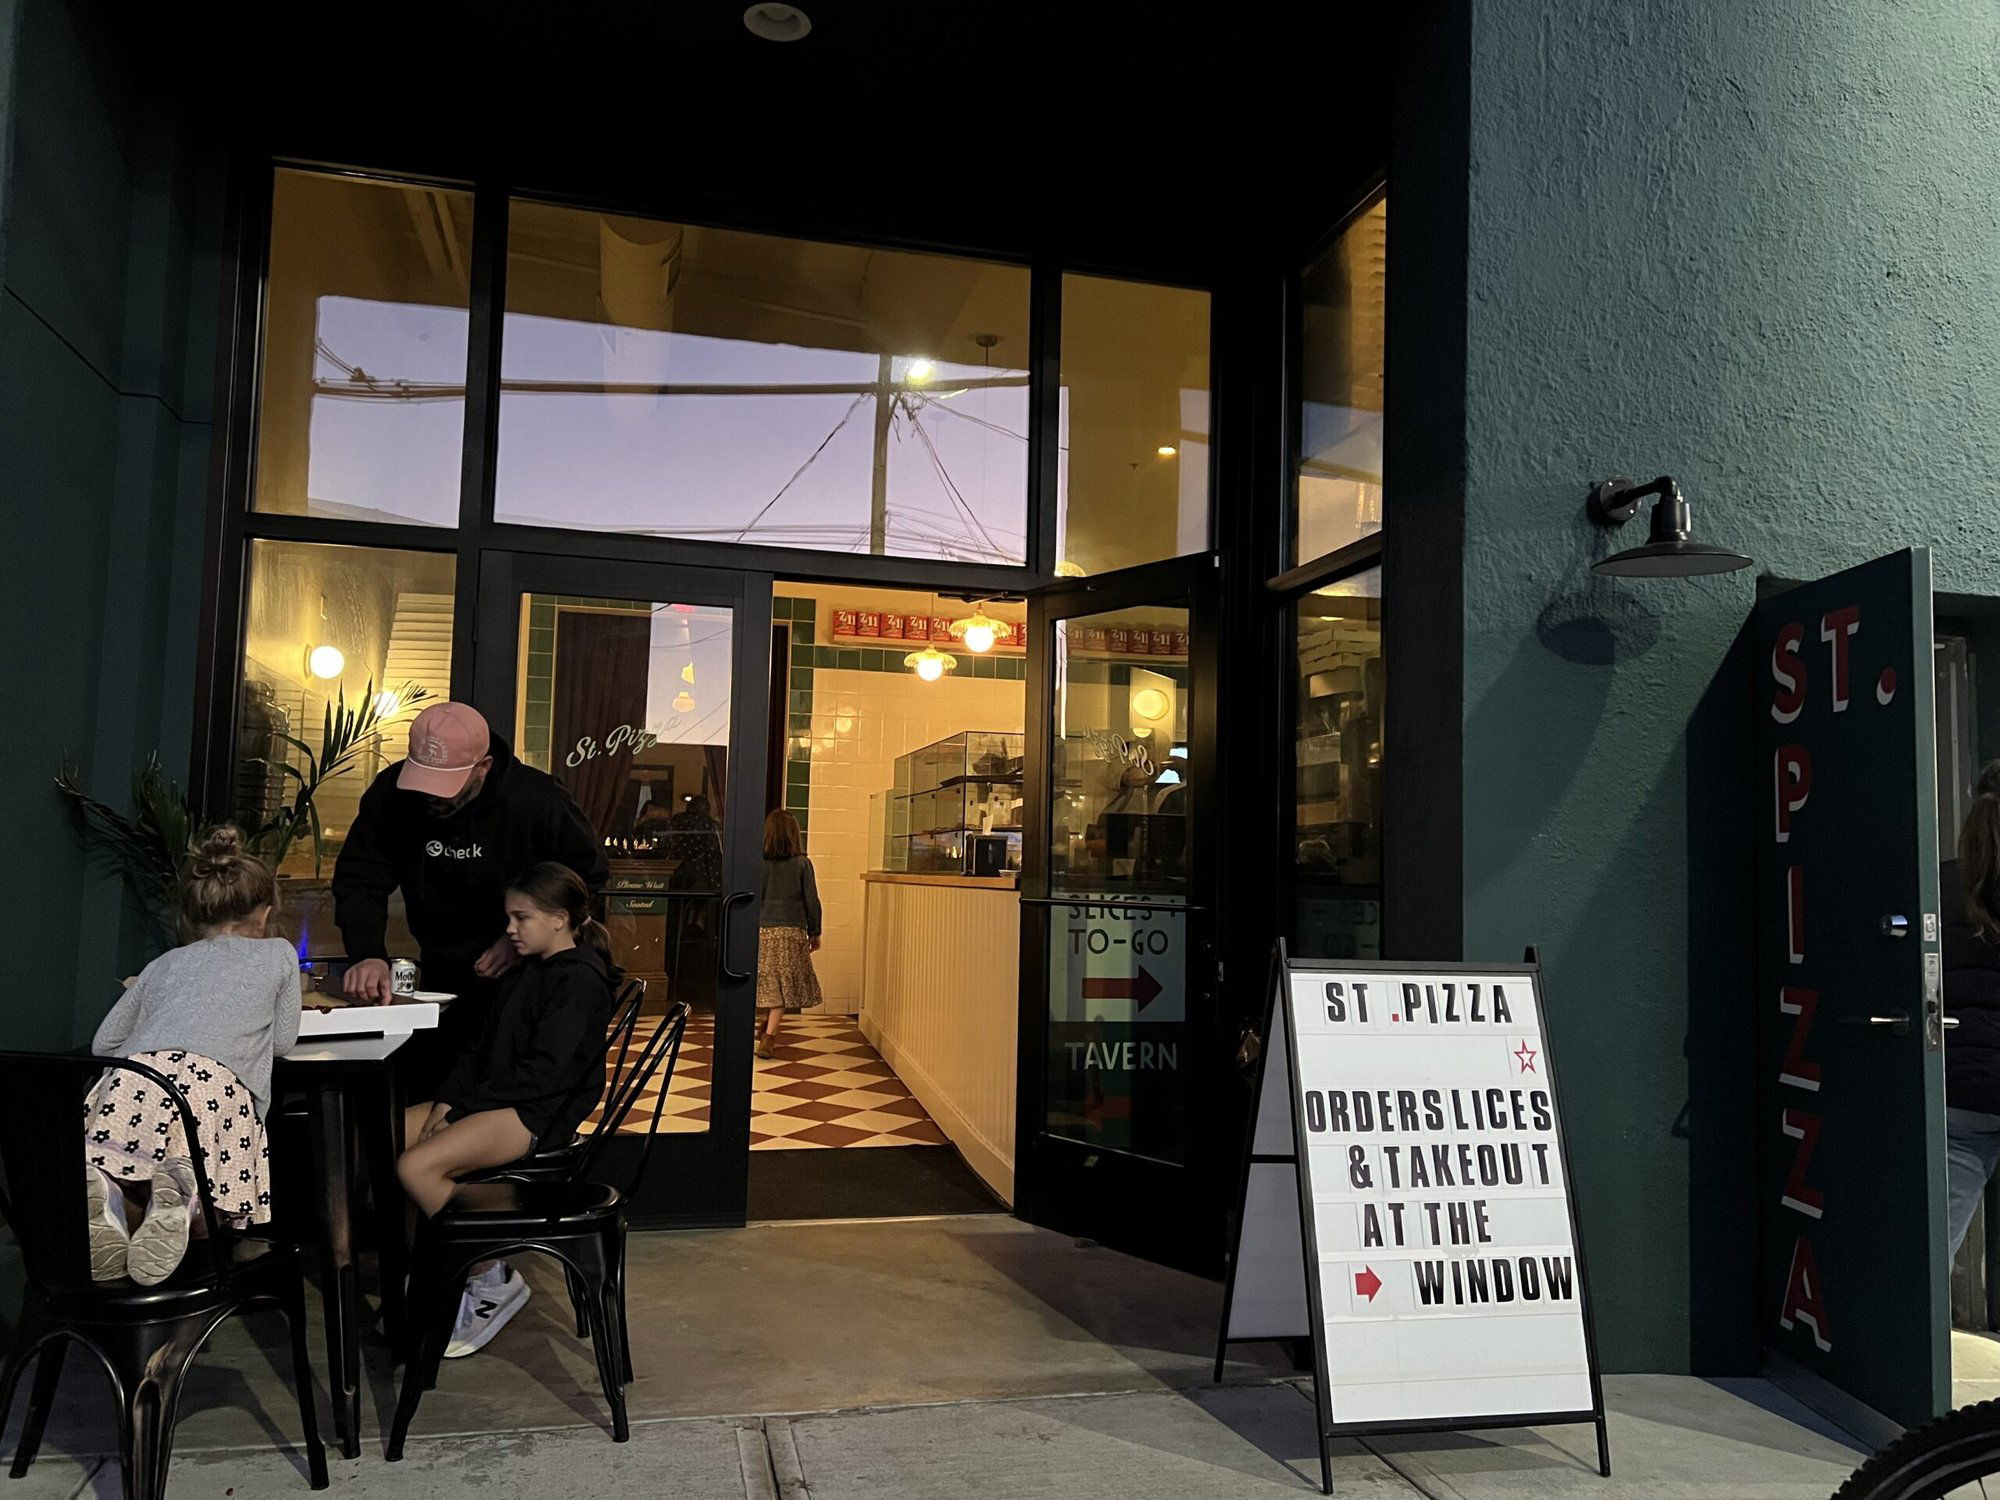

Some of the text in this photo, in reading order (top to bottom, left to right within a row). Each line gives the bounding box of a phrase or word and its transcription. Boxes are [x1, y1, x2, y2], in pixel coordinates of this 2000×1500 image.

[1769, 603, 1898, 725] ST.
[565, 736, 602, 767] St.
[1069, 894, 1152, 920] SLICES
[1068, 928, 1169, 955] TO-GO
[1064, 1041, 1178, 1071] TAVERN
[1773, 742, 1832, 1353] PIZZA
[1349, 1143, 1550, 1189] & TAKEOUT
[1364, 1200, 1492, 1247] AT THE
[1413, 1256, 1573, 1305] WINDOW
